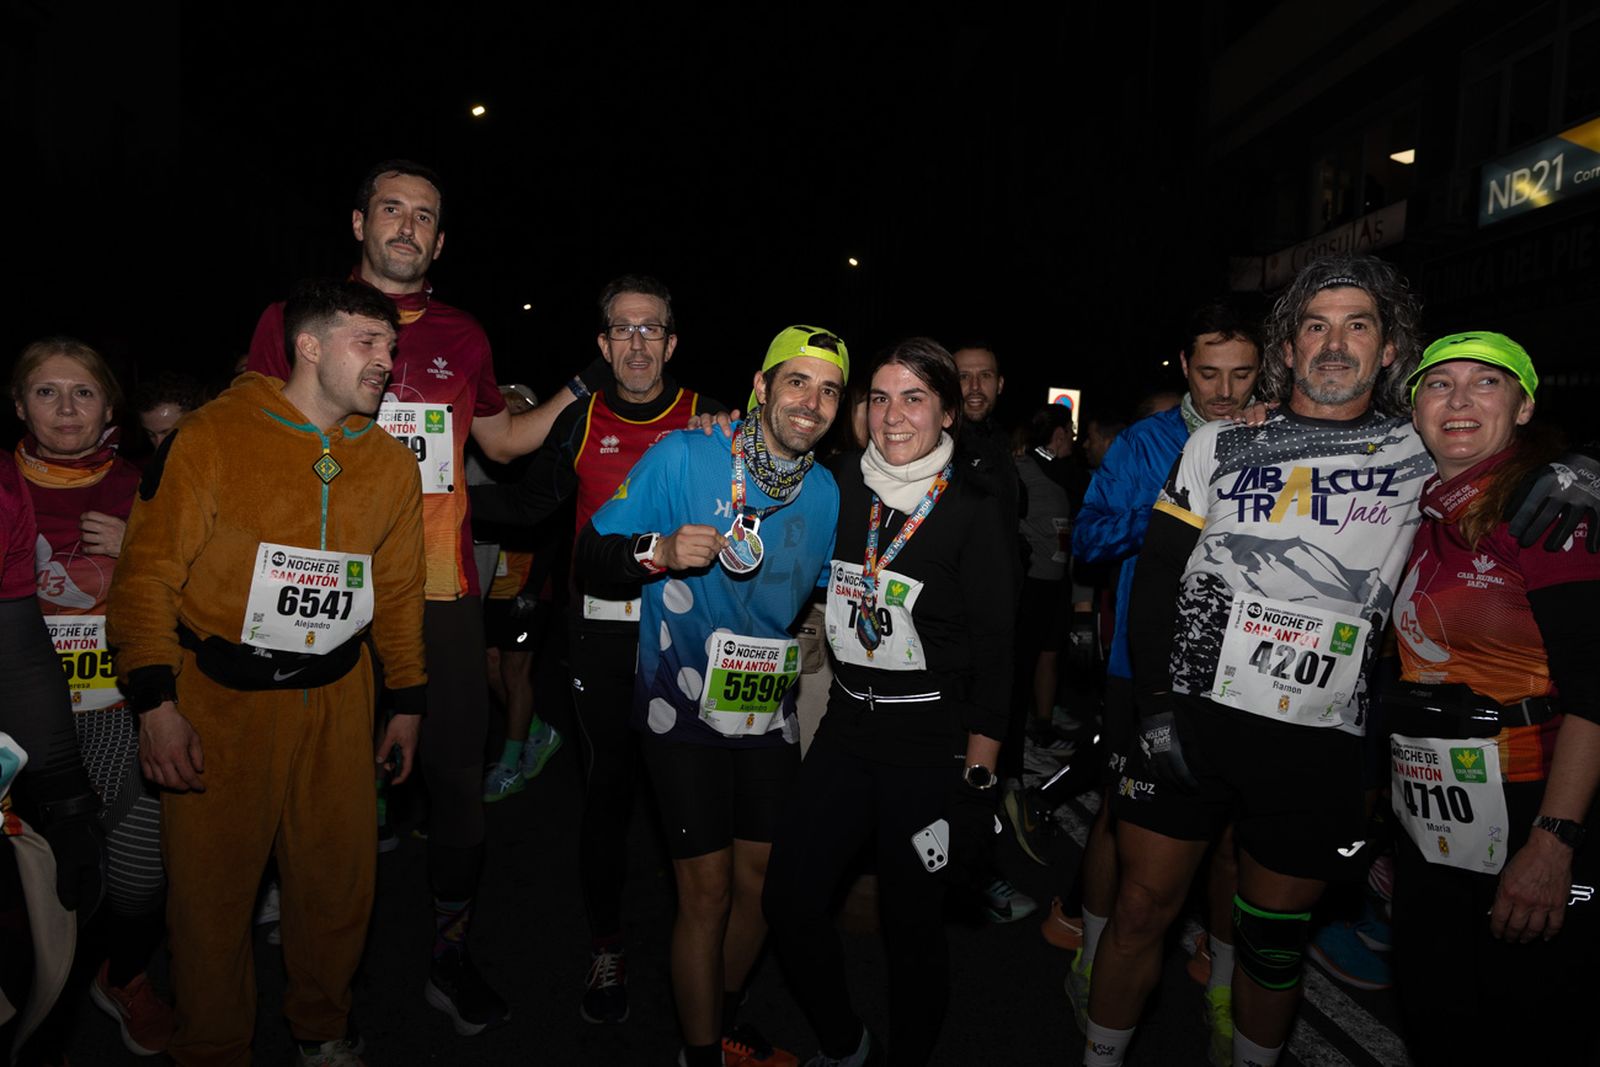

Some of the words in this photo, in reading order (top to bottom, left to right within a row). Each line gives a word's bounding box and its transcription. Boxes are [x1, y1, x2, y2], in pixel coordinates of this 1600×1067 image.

[1487, 152, 1564, 215] NB21
[1217, 466, 1399, 500] JABALCUZ
[1231, 481, 1339, 526] TRAIL
[1334, 497, 1392, 535] Jaén
[270, 569, 297, 583] SAN
[297, 573, 339, 587] ANTÓN
[287, 559, 325, 572] NOCHE
[326, 563, 340, 574] DE
[37, 570, 65, 597] 43
[835, 585, 851, 597] SAN
[277, 585, 353, 620] 6547
[47, 627, 80, 637] OCHE
[84, 627, 97, 636] DE
[294, 620, 331, 630] Alejandro
[1262, 611, 1303, 630] NOCHE
[1305, 621, 1324, 633] DE
[1401, 611, 1424, 644] 43
[55, 637, 98, 649] ANTÓN
[1243, 621, 1272, 637] SAN
[1272, 628, 1320, 648] ANTÓN
[721, 658, 744, 670] SAN
[744, 660, 777, 672] ANTÓN
[736, 647, 767, 659] NOCHE
[768, 651, 780, 660] DE
[1249, 641, 1337, 688] 4207
[723, 672, 789, 702] 5598
[1424, 752, 1439, 764] DE
[1404, 764, 1443, 781] ANTÓN
[1404, 780, 1474, 823] 4710
